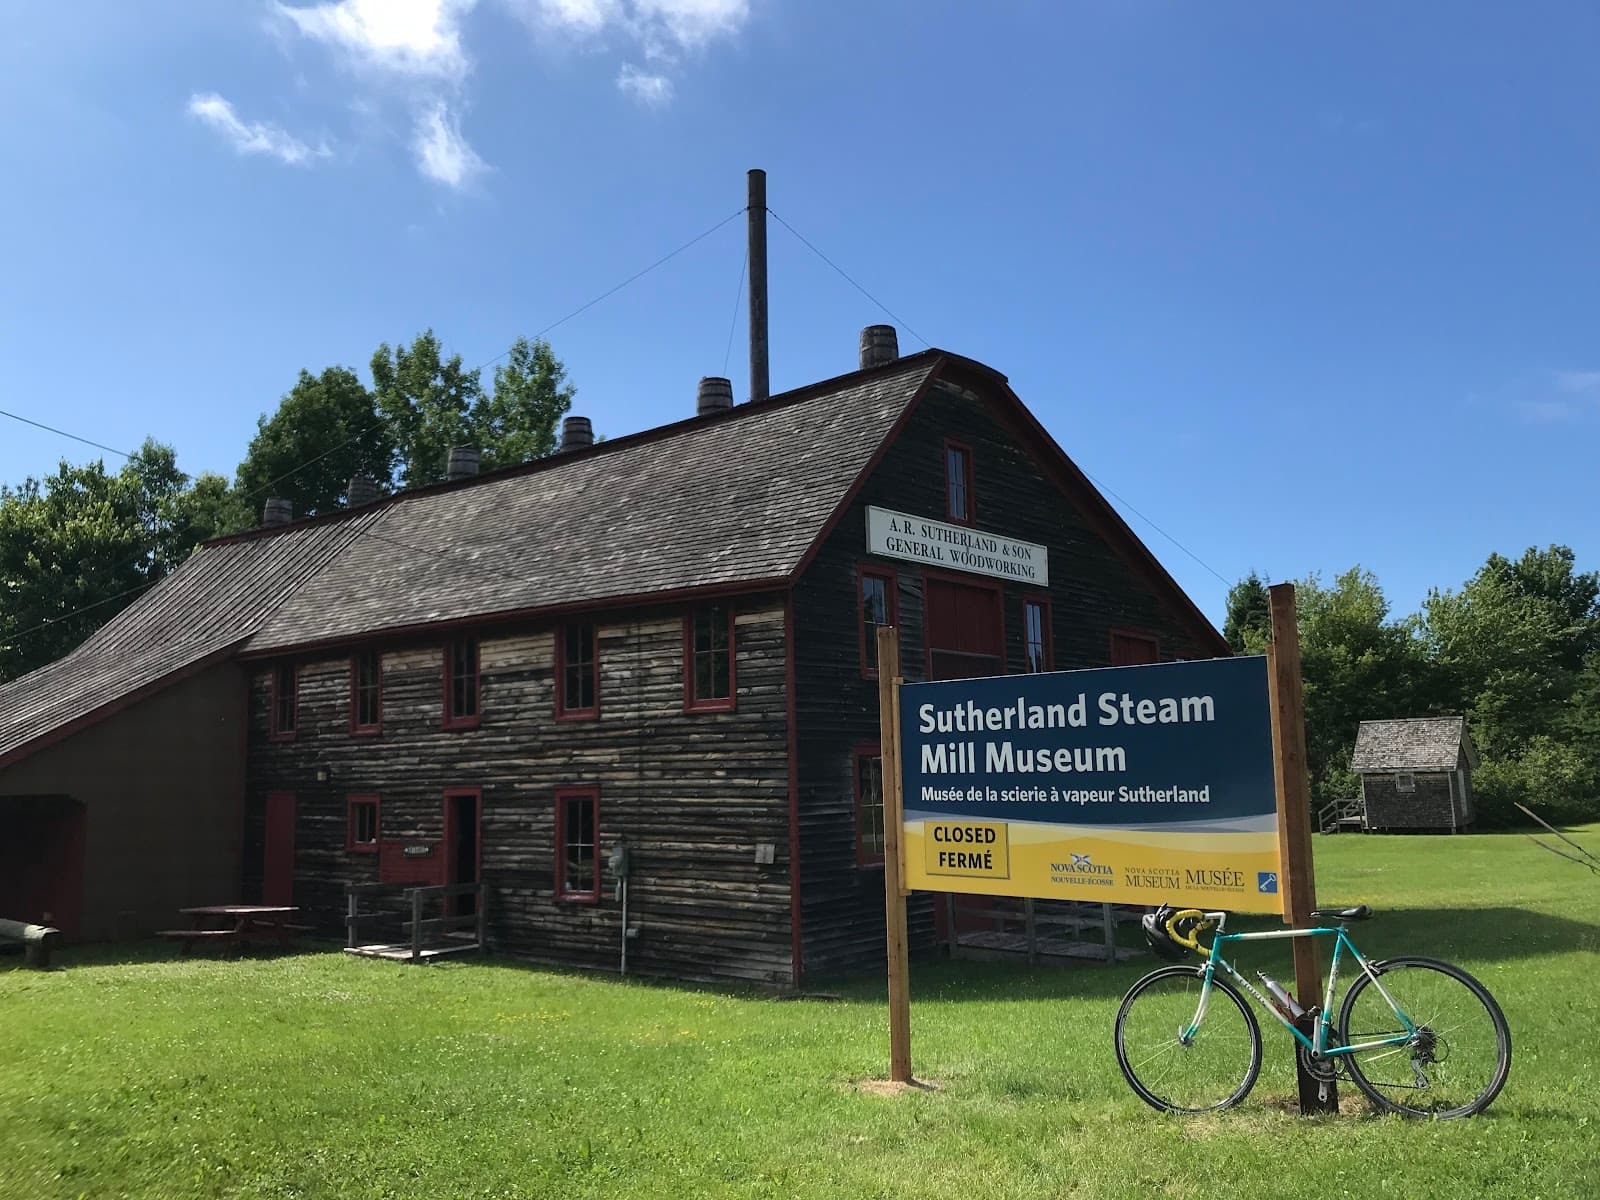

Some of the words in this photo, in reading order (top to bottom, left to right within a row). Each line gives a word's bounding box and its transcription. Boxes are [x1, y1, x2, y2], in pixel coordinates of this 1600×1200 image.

[921, 524, 997, 553] SUTHERLAND
[1002, 543, 1010, 556] &
[1012, 544, 1031, 560] SON
[886, 537, 943, 561] GENERAL
[950, 549, 1035, 579] WOODWORKING
[919, 693, 1087, 734] Sutherland
[1098, 692, 1215, 726] Steam
[920, 741, 975, 774] Mill
[985, 741, 1126, 774] Museum
[921, 785, 964, 802] Musée
[966, 785, 983, 802] de
[985, 786, 998, 802] la
[1000, 786, 1047, 802] scierie
[1050, 786, 1059, 802] à
[1062, 789, 1115, 806] vapeur
[1118, 785, 1211, 803] Sutherland
[934, 826, 996, 844] CLOSED
[939, 850, 993, 870] FERMÉ
[1050, 863, 1075, 873] NOVA
[1077, 864, 1113, 875] SCOTIA
[1148, 867, 1180, 875] SCOTIA
[1185, 867, 1245, 887] MUSÉE
[1126, 874, 1181, 889] MUSEUM
